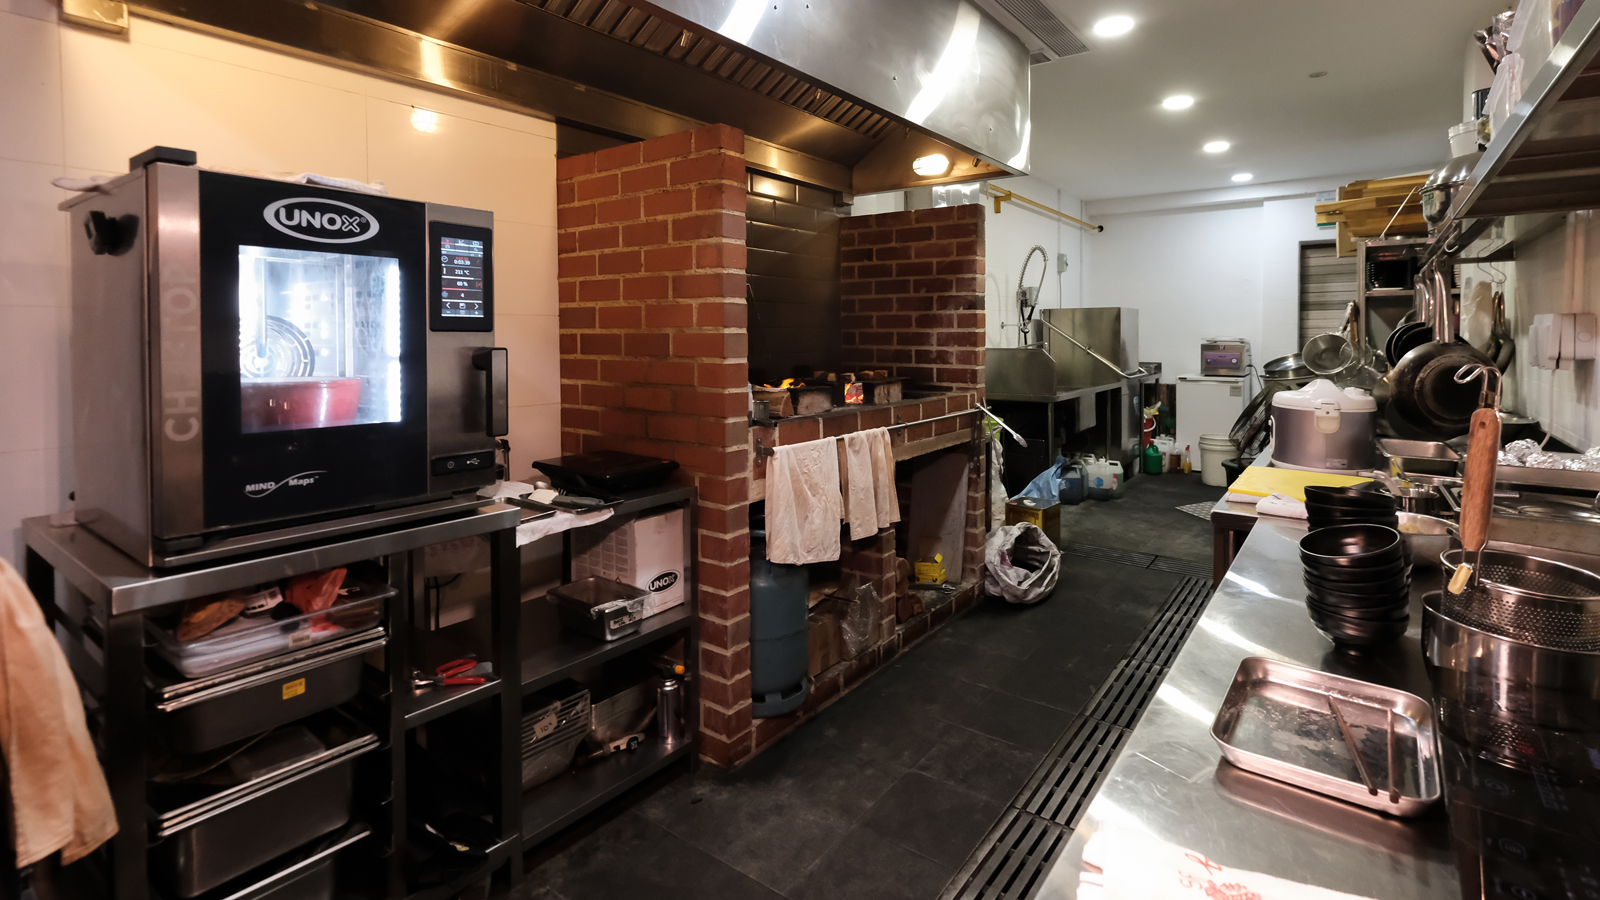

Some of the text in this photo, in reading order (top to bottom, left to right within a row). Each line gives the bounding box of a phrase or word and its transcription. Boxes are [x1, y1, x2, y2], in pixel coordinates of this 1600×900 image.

[278, 206, 360, 233] UNOX
[163, 262, 199, 442] CHTOP
[245, 481, 275, 492] MIND
[649, 574, 675, 591] UNOX
